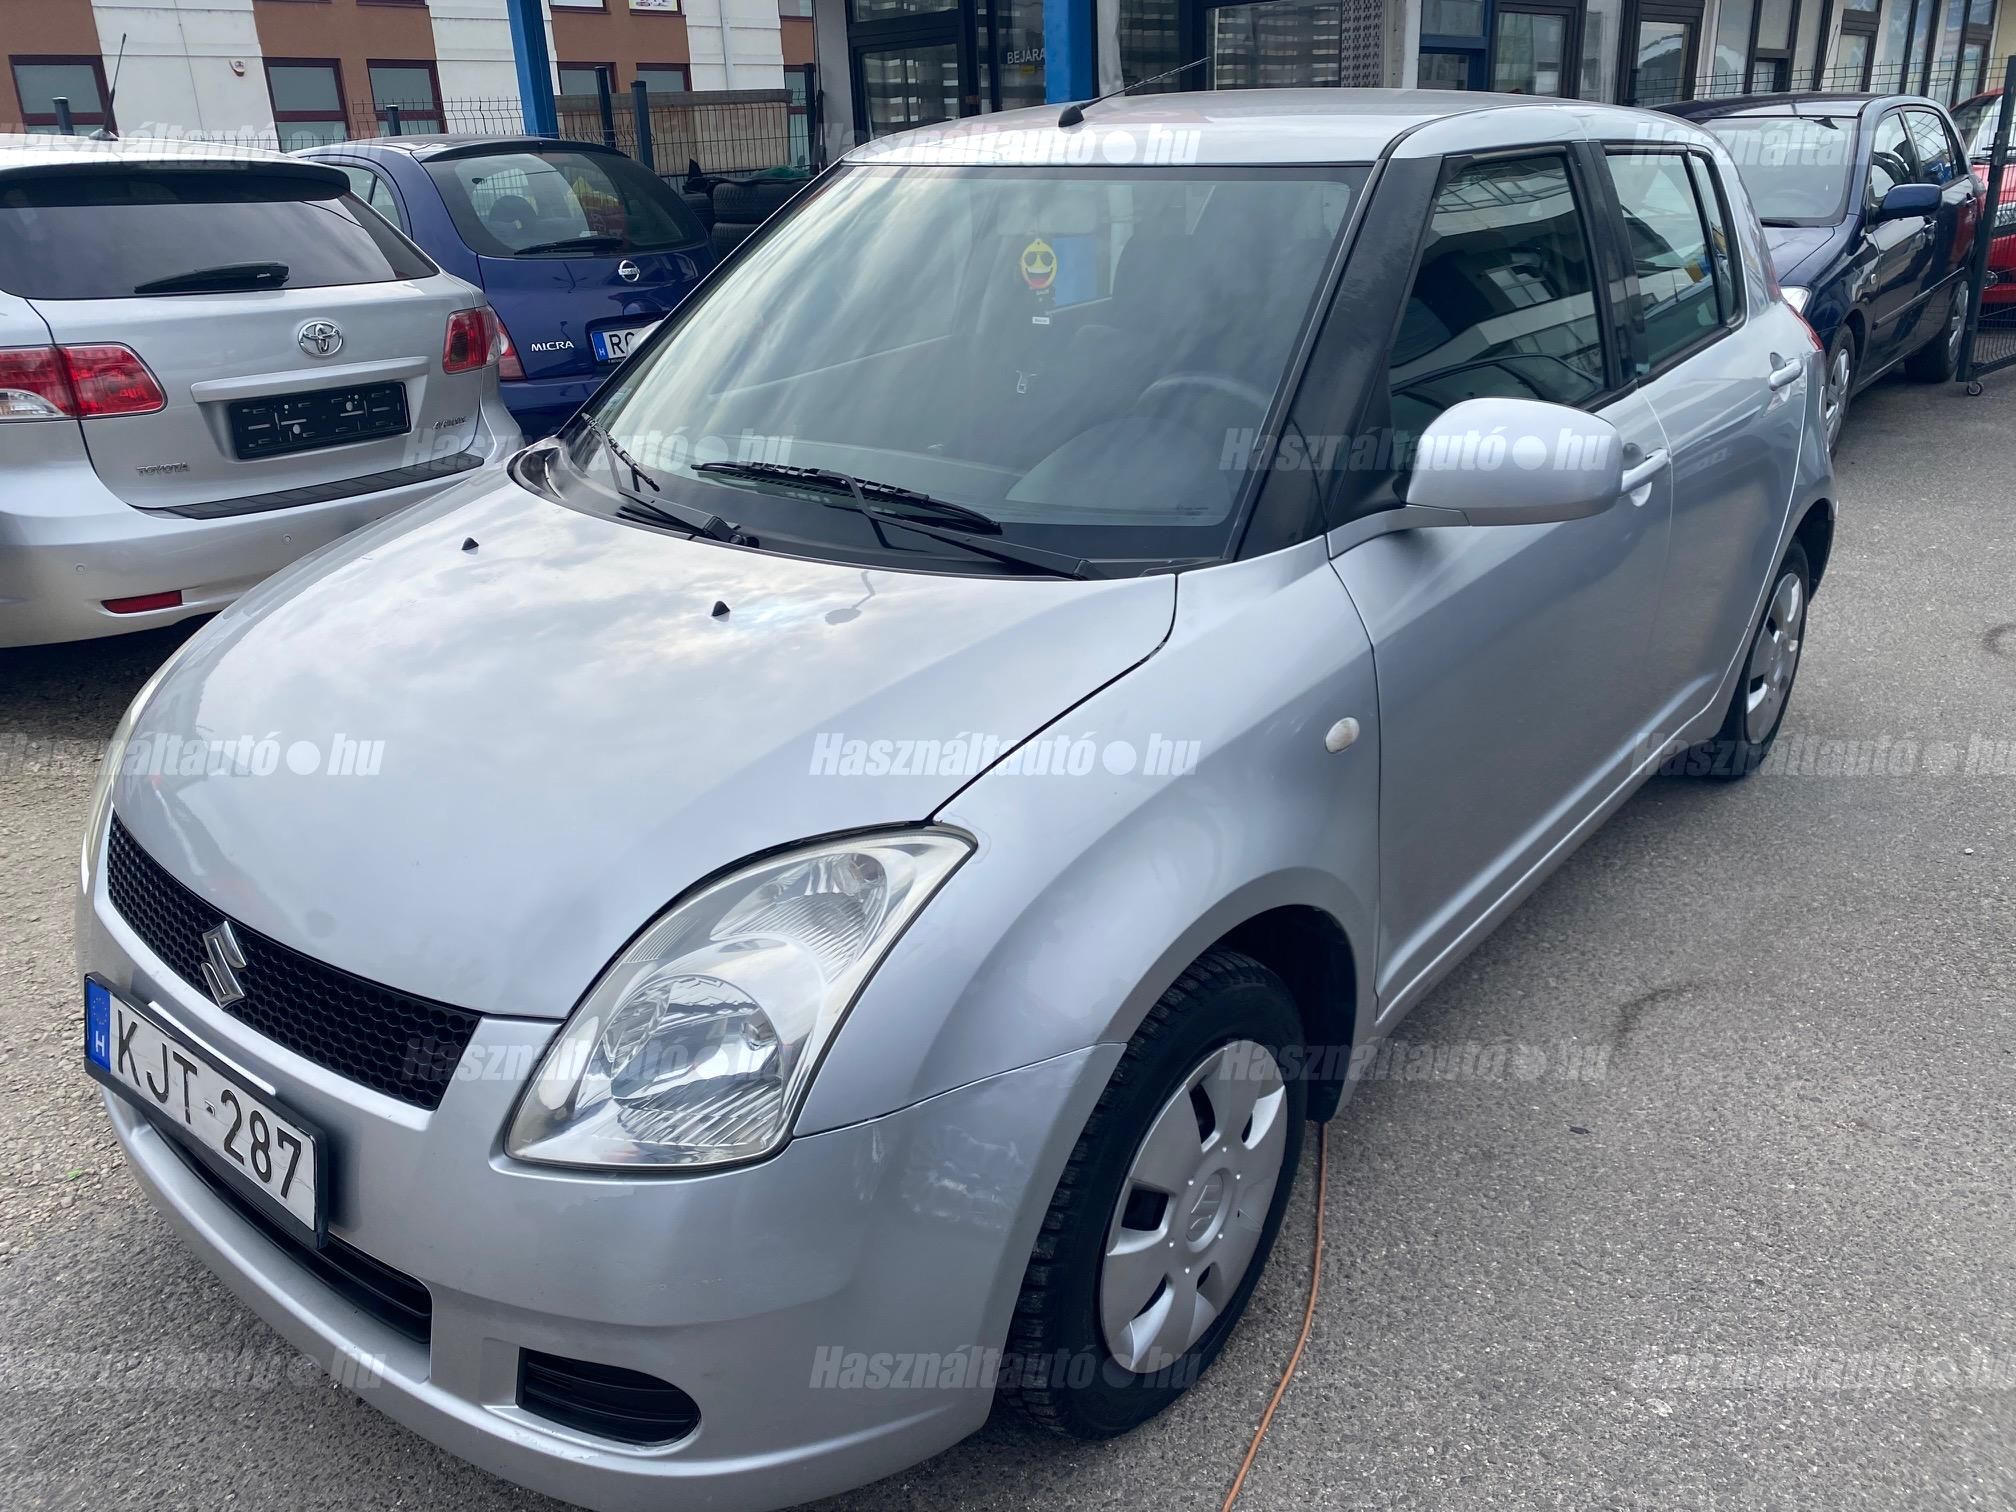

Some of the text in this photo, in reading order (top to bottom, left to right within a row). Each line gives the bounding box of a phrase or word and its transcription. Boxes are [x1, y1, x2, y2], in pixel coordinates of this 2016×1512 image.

[531, 340, 575, 352] MICRA
[95, 1031, 105, 1057] H
[117, 1009, 302, 1199] KJT-287
